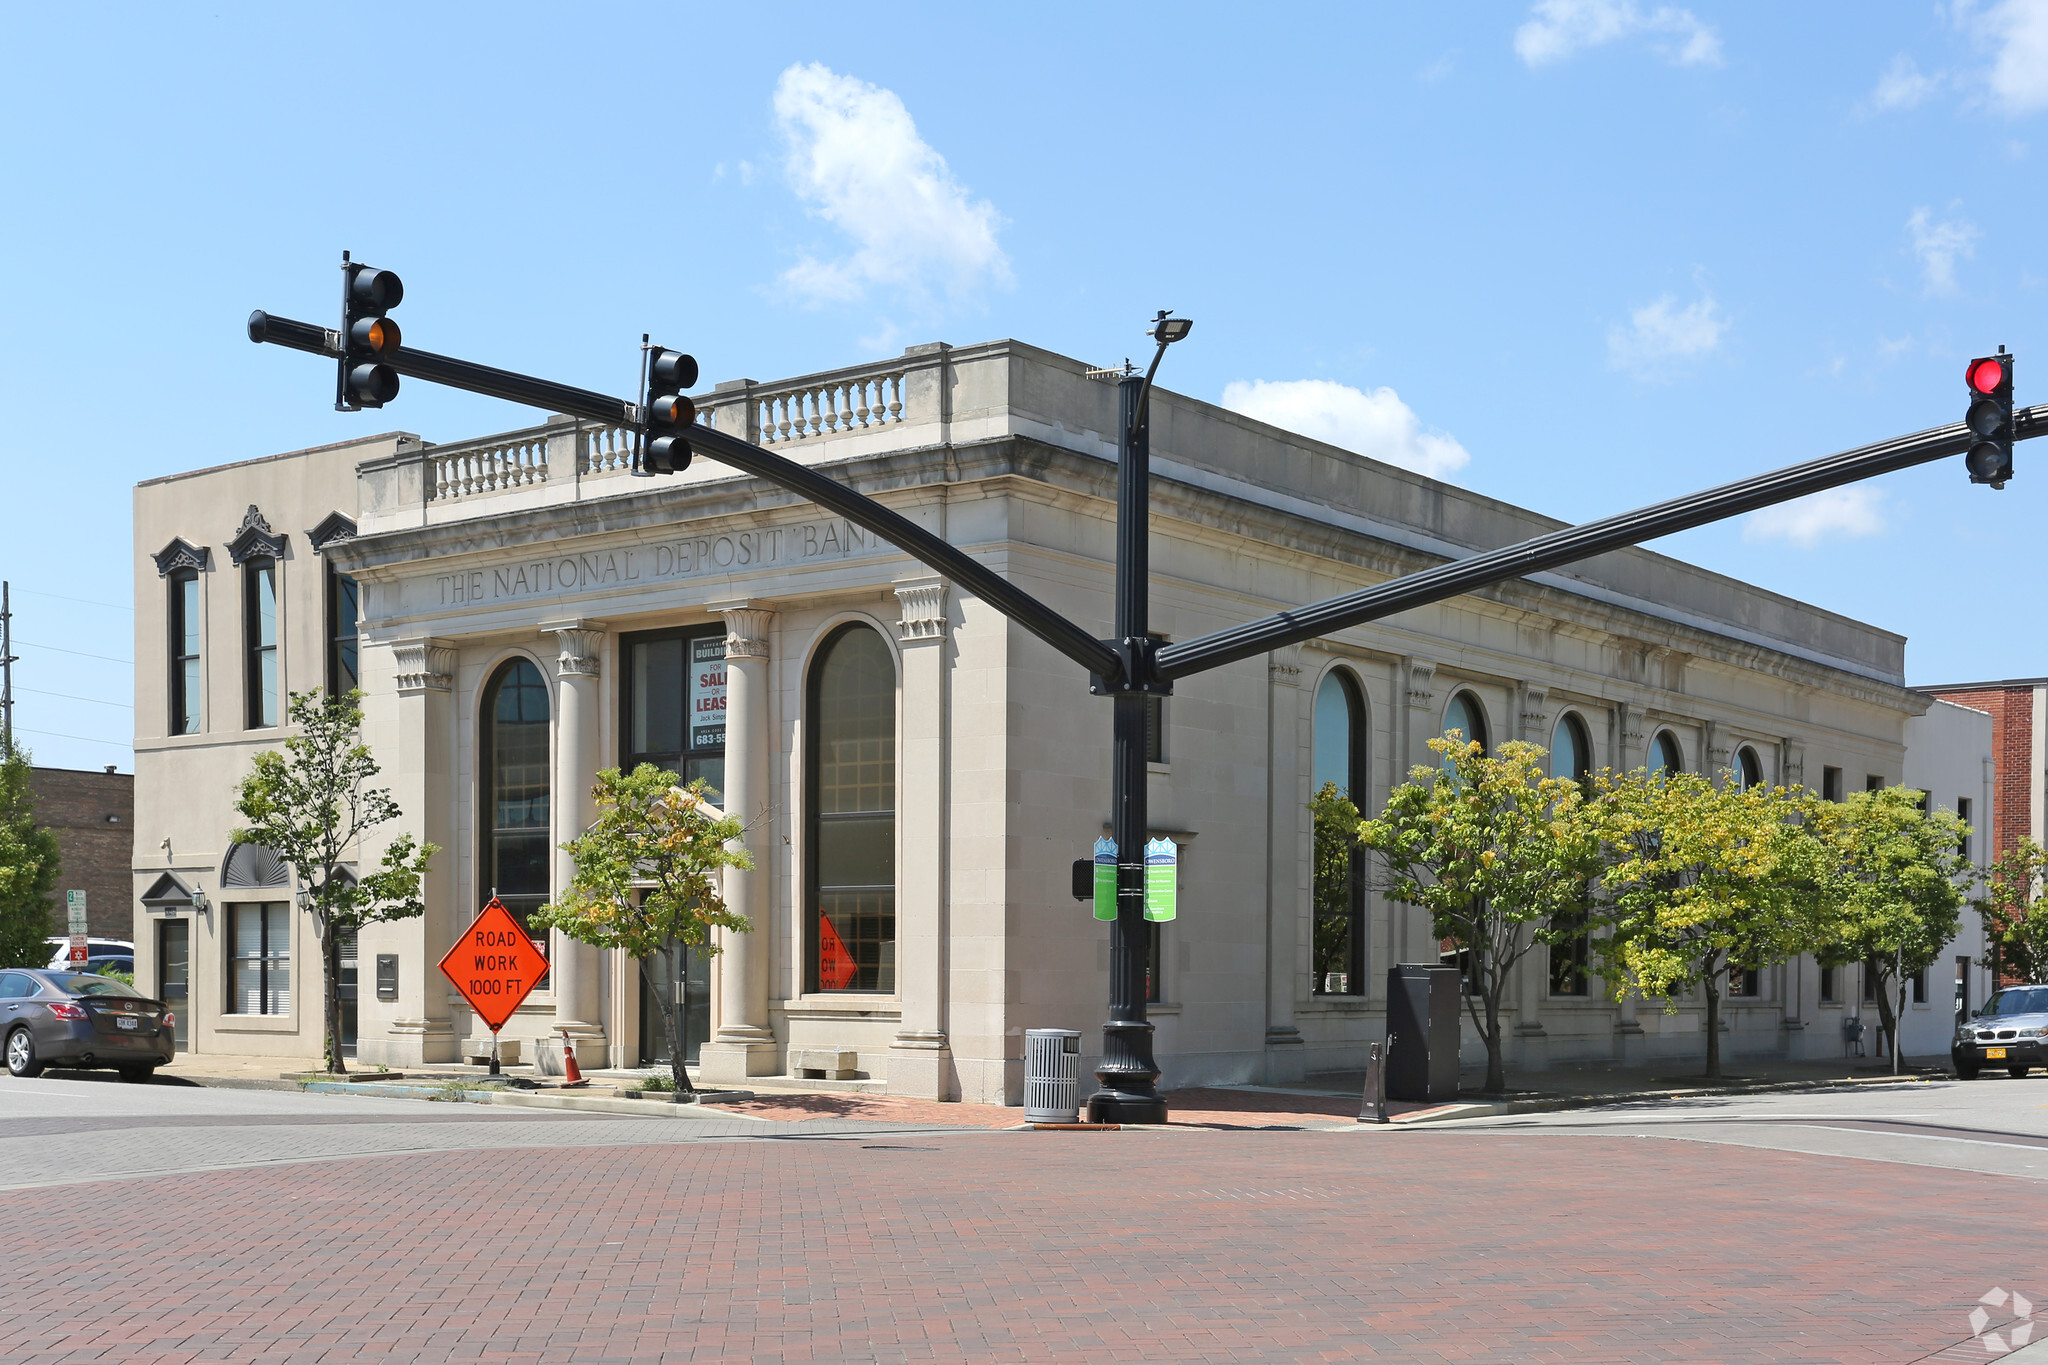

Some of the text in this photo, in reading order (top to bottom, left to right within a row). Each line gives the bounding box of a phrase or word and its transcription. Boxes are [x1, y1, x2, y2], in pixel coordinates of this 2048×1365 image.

[436, 518, 884, 605] THE NATIONAL DEPOSIT BAN
[700, 714, 711, 722] Jack
[475, 931, 516, 947] ROAD
[474, 955, 518, 971] WORK
[469, 979, 522, 995] 1000 FT
